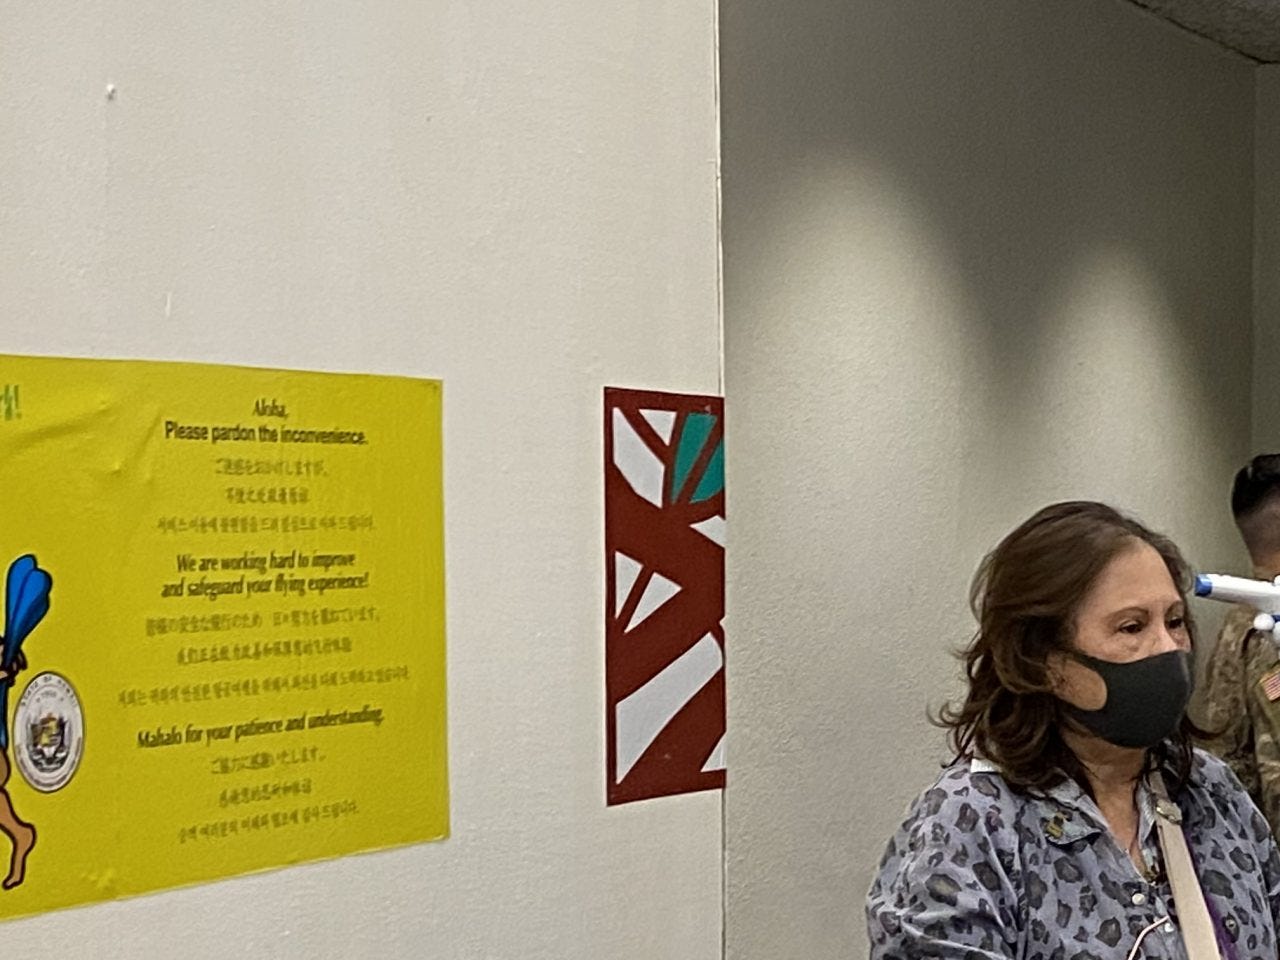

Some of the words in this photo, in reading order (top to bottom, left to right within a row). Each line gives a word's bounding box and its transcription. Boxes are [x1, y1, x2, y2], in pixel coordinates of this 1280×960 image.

[165, 421, 208, 441] Please
[212, 424, 256, 444] pardon
[259, 425, 278, 443] the
[281, 426, 369, 445] inconvenience.
[177, 553, 197, 573] We
[199, 556, 219, 572] are
[221, 551, 267, 575] working
[269, 550, 296, 570] hard
[298, 552, 310, 569] to
[311, 550, 356, 571] improve
[161, 577, 184, 598] and
[187, 575, 244, 601] safeguard
[247, 578, 274, 598] your
[275, 573, 306, 597] flying
[308, 572, 370, 596] experience!
[138, 726, 182, 748] Mahalo
[185, 724, 203, 743] for
[206, 725, 234, 747] your
[235, 718, 283, 743] patience
[285, 711, 306, 732] and
